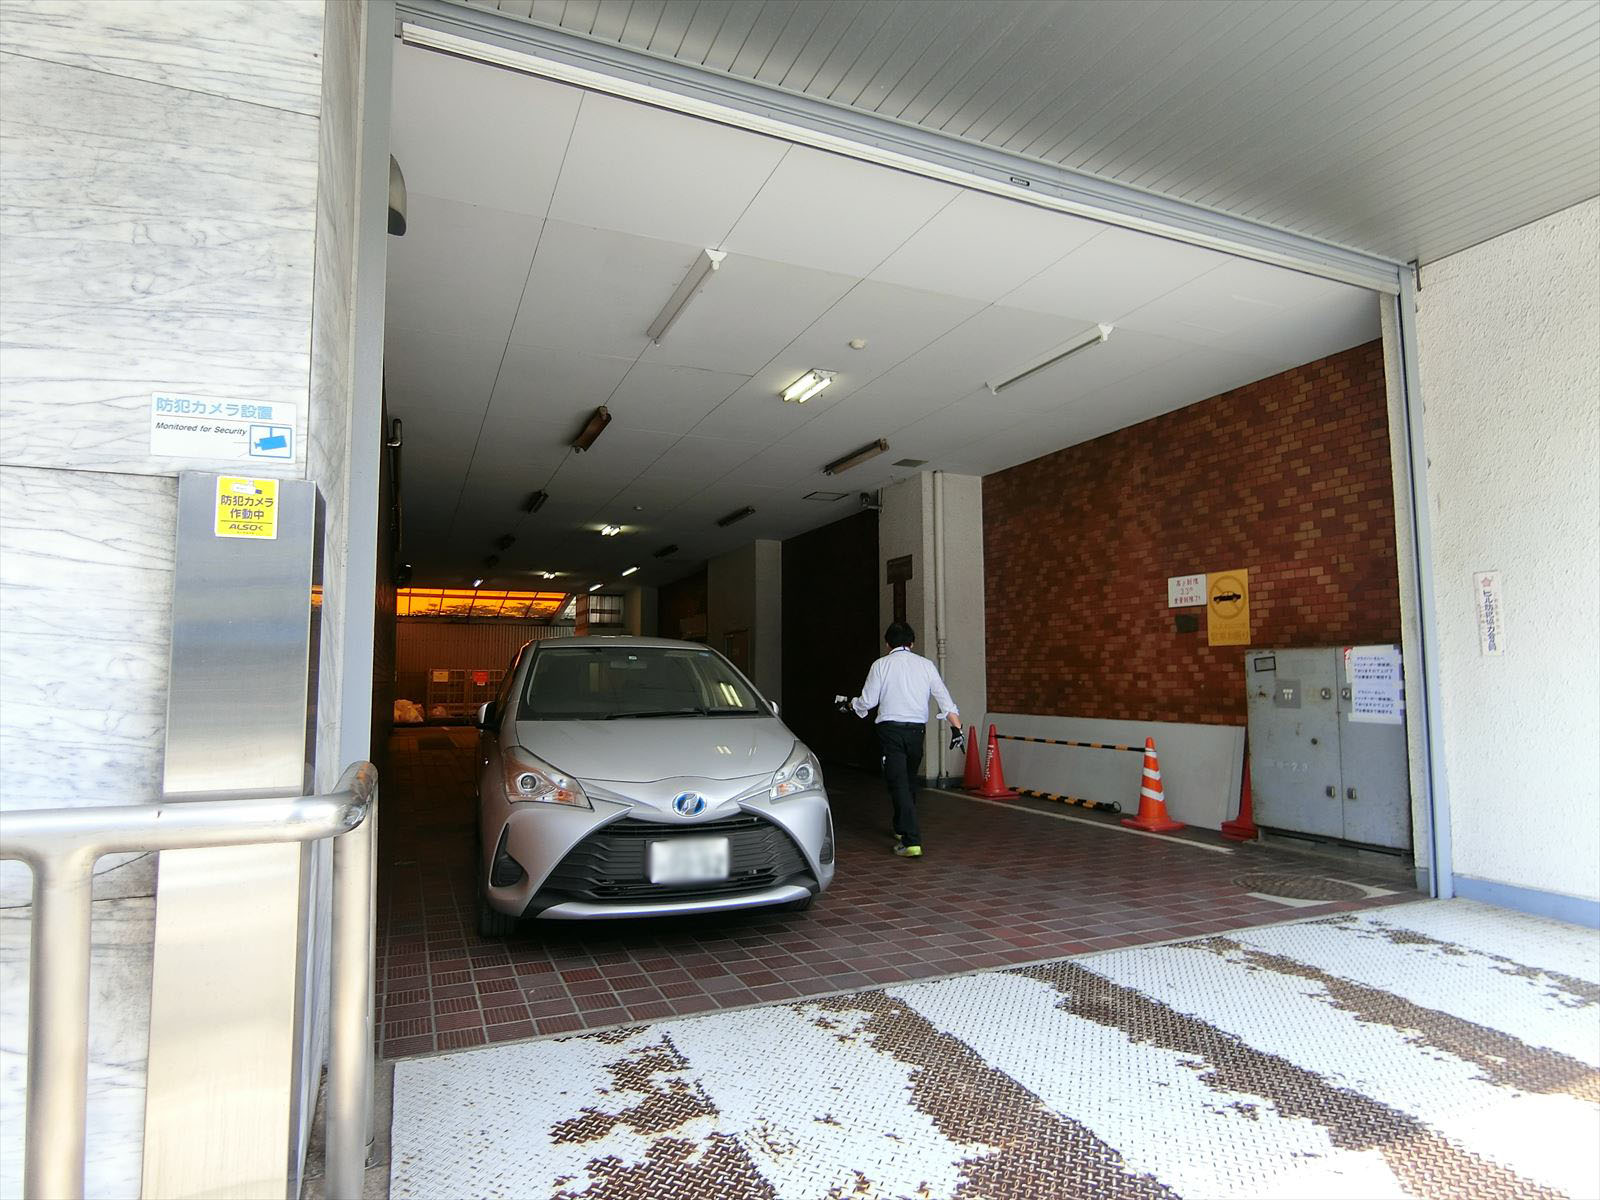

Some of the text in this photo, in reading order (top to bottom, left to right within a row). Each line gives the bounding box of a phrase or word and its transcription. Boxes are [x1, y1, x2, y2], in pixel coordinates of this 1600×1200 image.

[156, 397, 273, 420] 防犯カメラ設置
[155, 422, 248, 437] Monitored for Security
[220, 494, 274, 508] 防犯カメラ
[230, 508, 264, 520] 作動中
[228, 523, 264, 532] ALSOK
